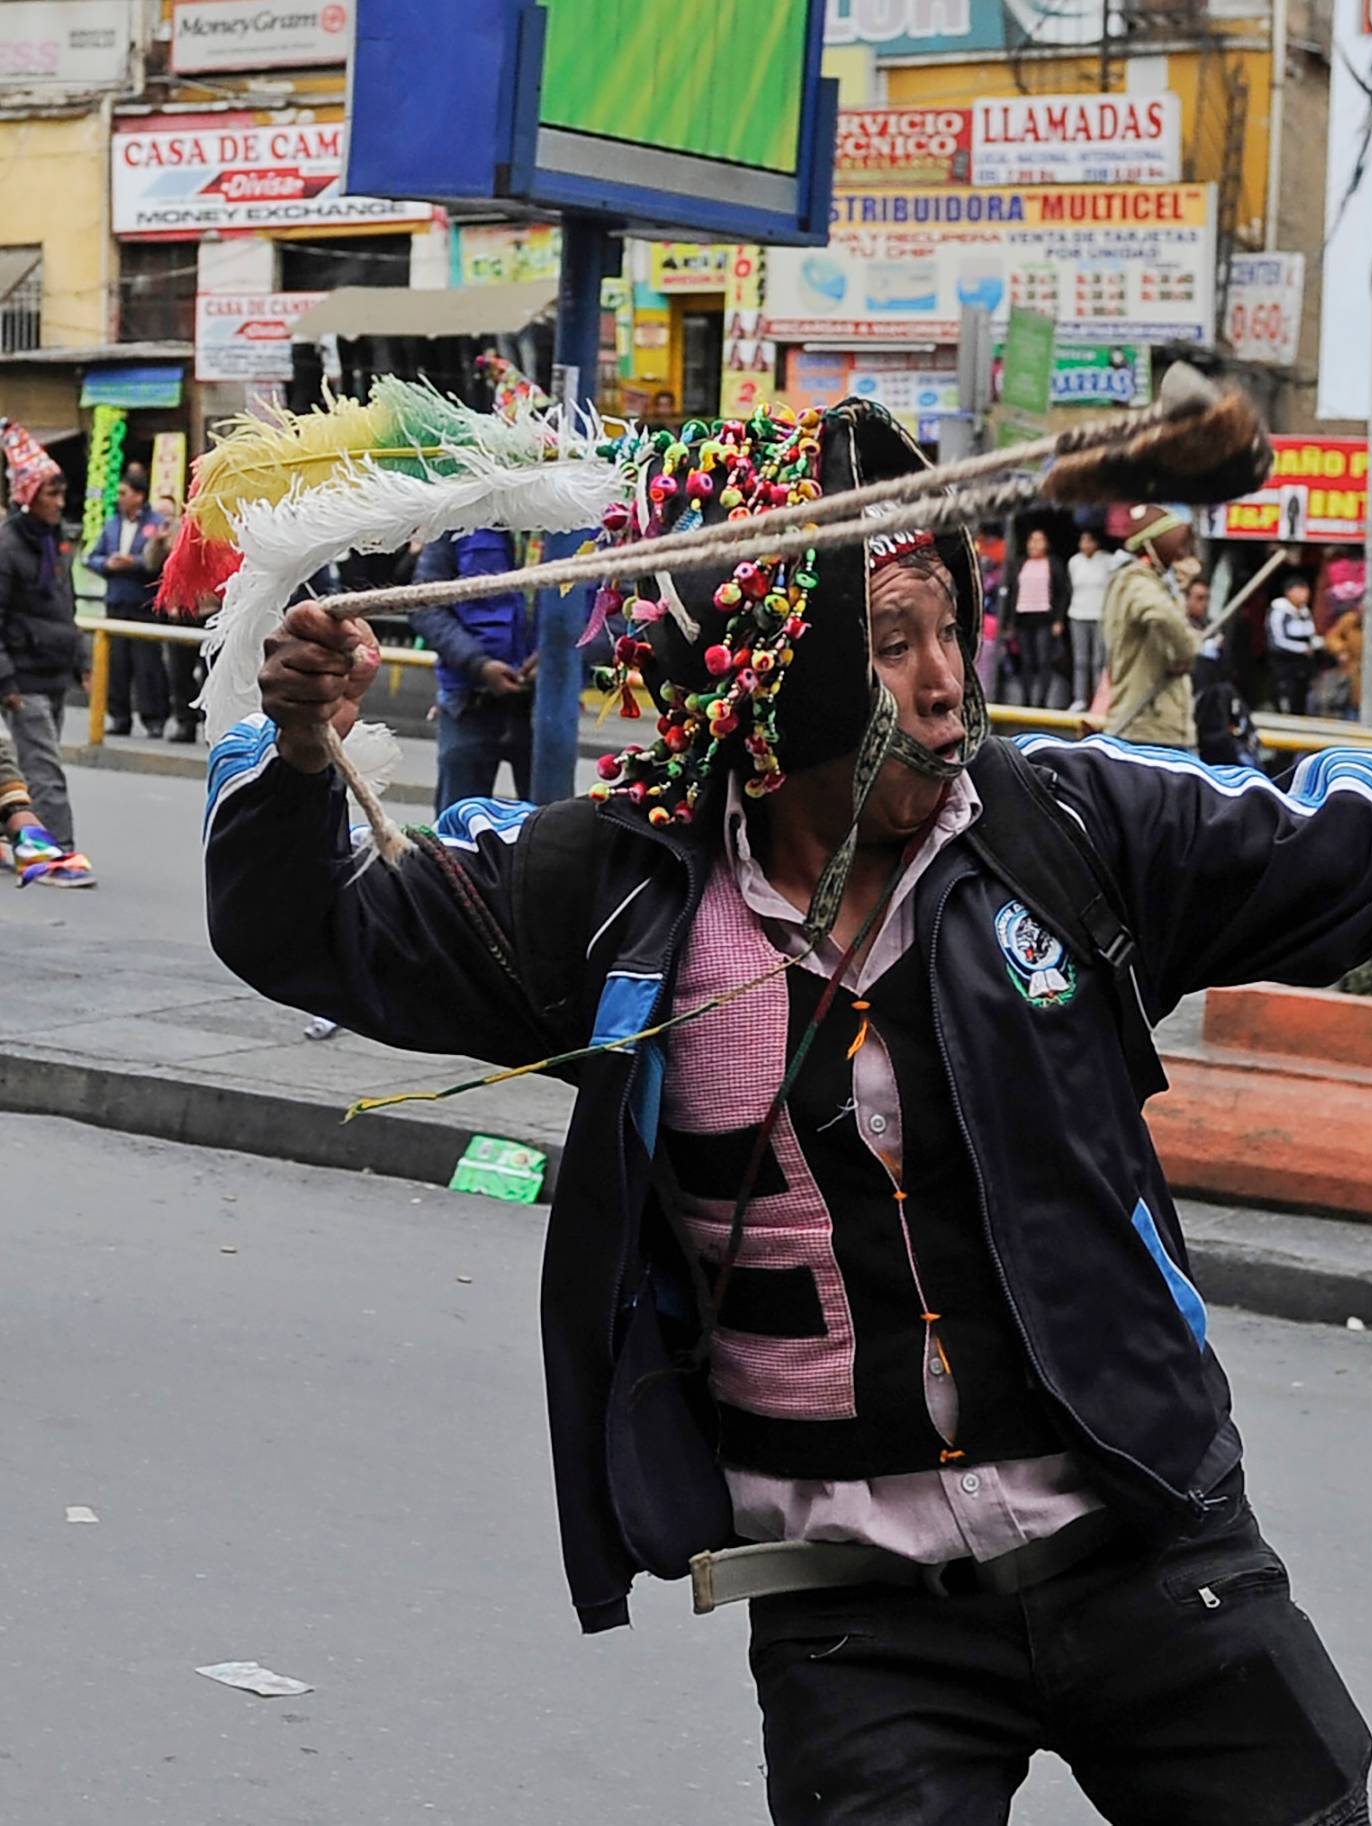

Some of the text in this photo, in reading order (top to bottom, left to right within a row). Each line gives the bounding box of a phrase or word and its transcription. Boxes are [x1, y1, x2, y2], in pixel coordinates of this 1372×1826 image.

[178, 10, 317, 38] MoneyGram
[983, 102, 1164, 143] LLAMADAS
[124, 130, 340, 167] CASA DE CAM
[836, 134, 958, 159] CNICO
[137, 200, 405, 225] MONEY EXCHANGE
[1104, 230, 1199, 242] TARJETAS
[1273, 444, 1347, 478] AÑO
